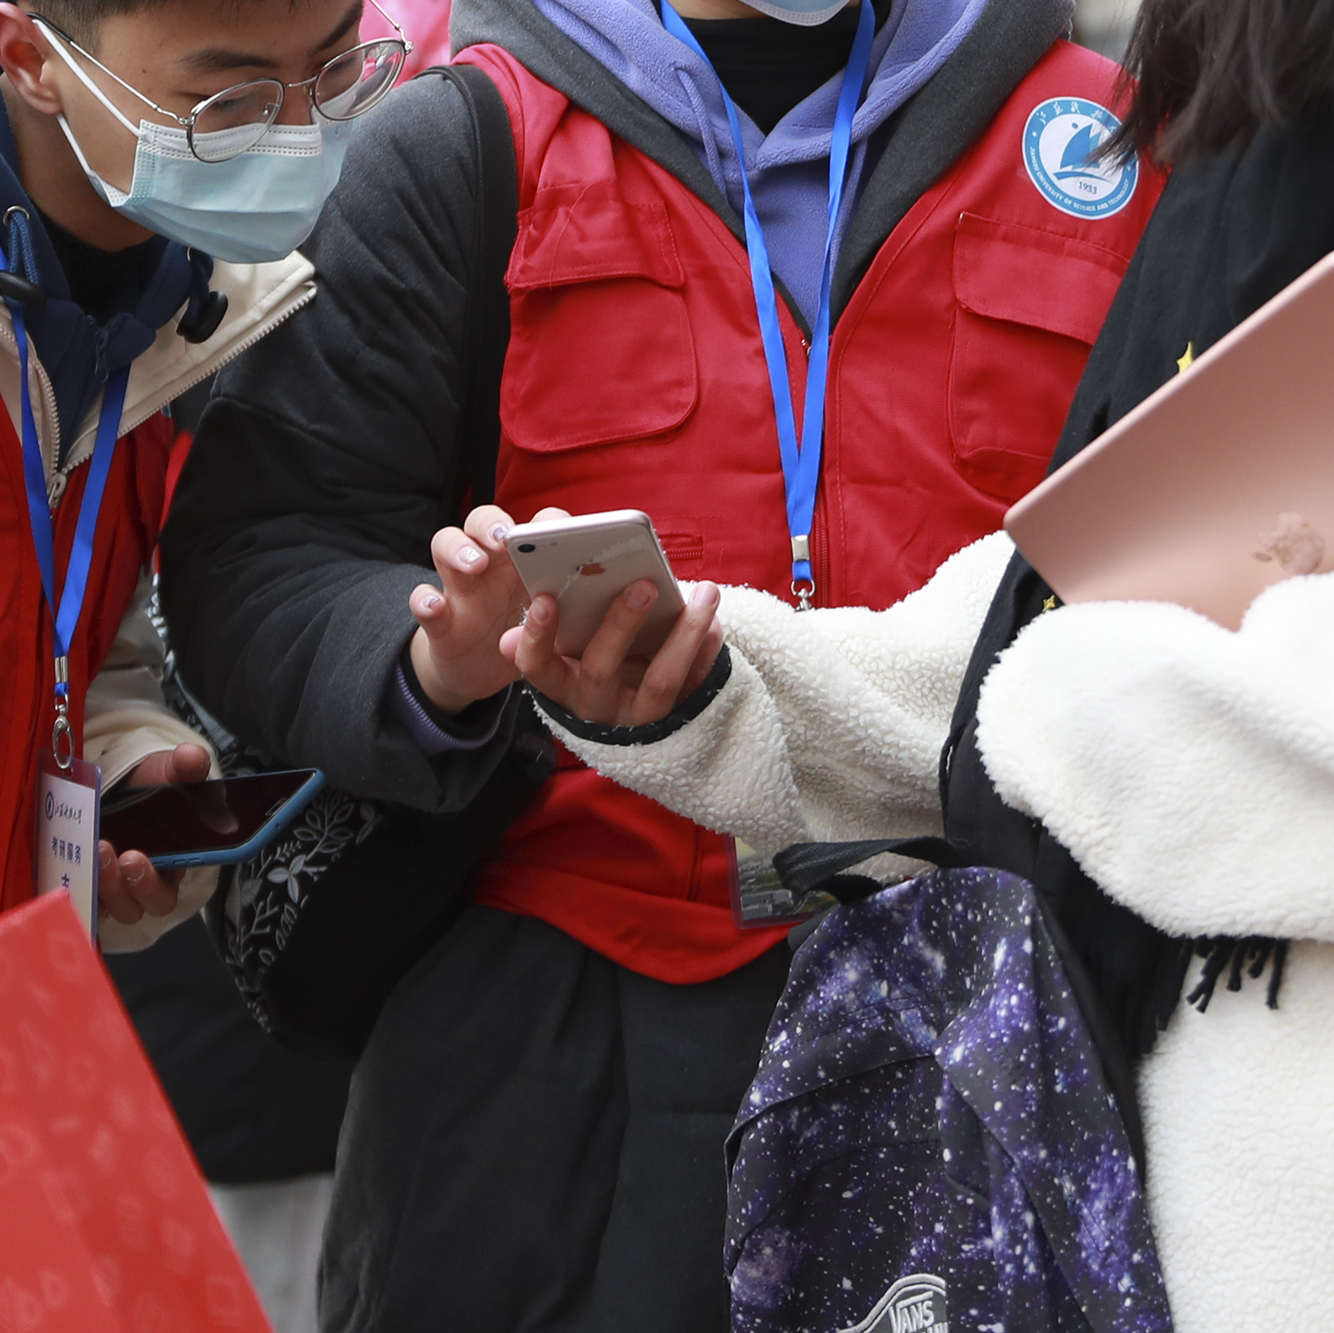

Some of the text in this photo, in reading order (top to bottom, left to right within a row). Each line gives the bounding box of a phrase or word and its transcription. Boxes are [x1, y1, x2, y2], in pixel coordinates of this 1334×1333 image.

[1037, 171, 1063, 201] UNIVERSITY
[1064, 197, 1072, 206] OF
[1073, 201, 1097, 212] SCIENCE
[1097, 202, 1109, 211] AND
[1078, 181, 1098, 195] 1933
[51, 836, 82, 865] 考研服务
[888, 1290, 935, 1333] VANS
